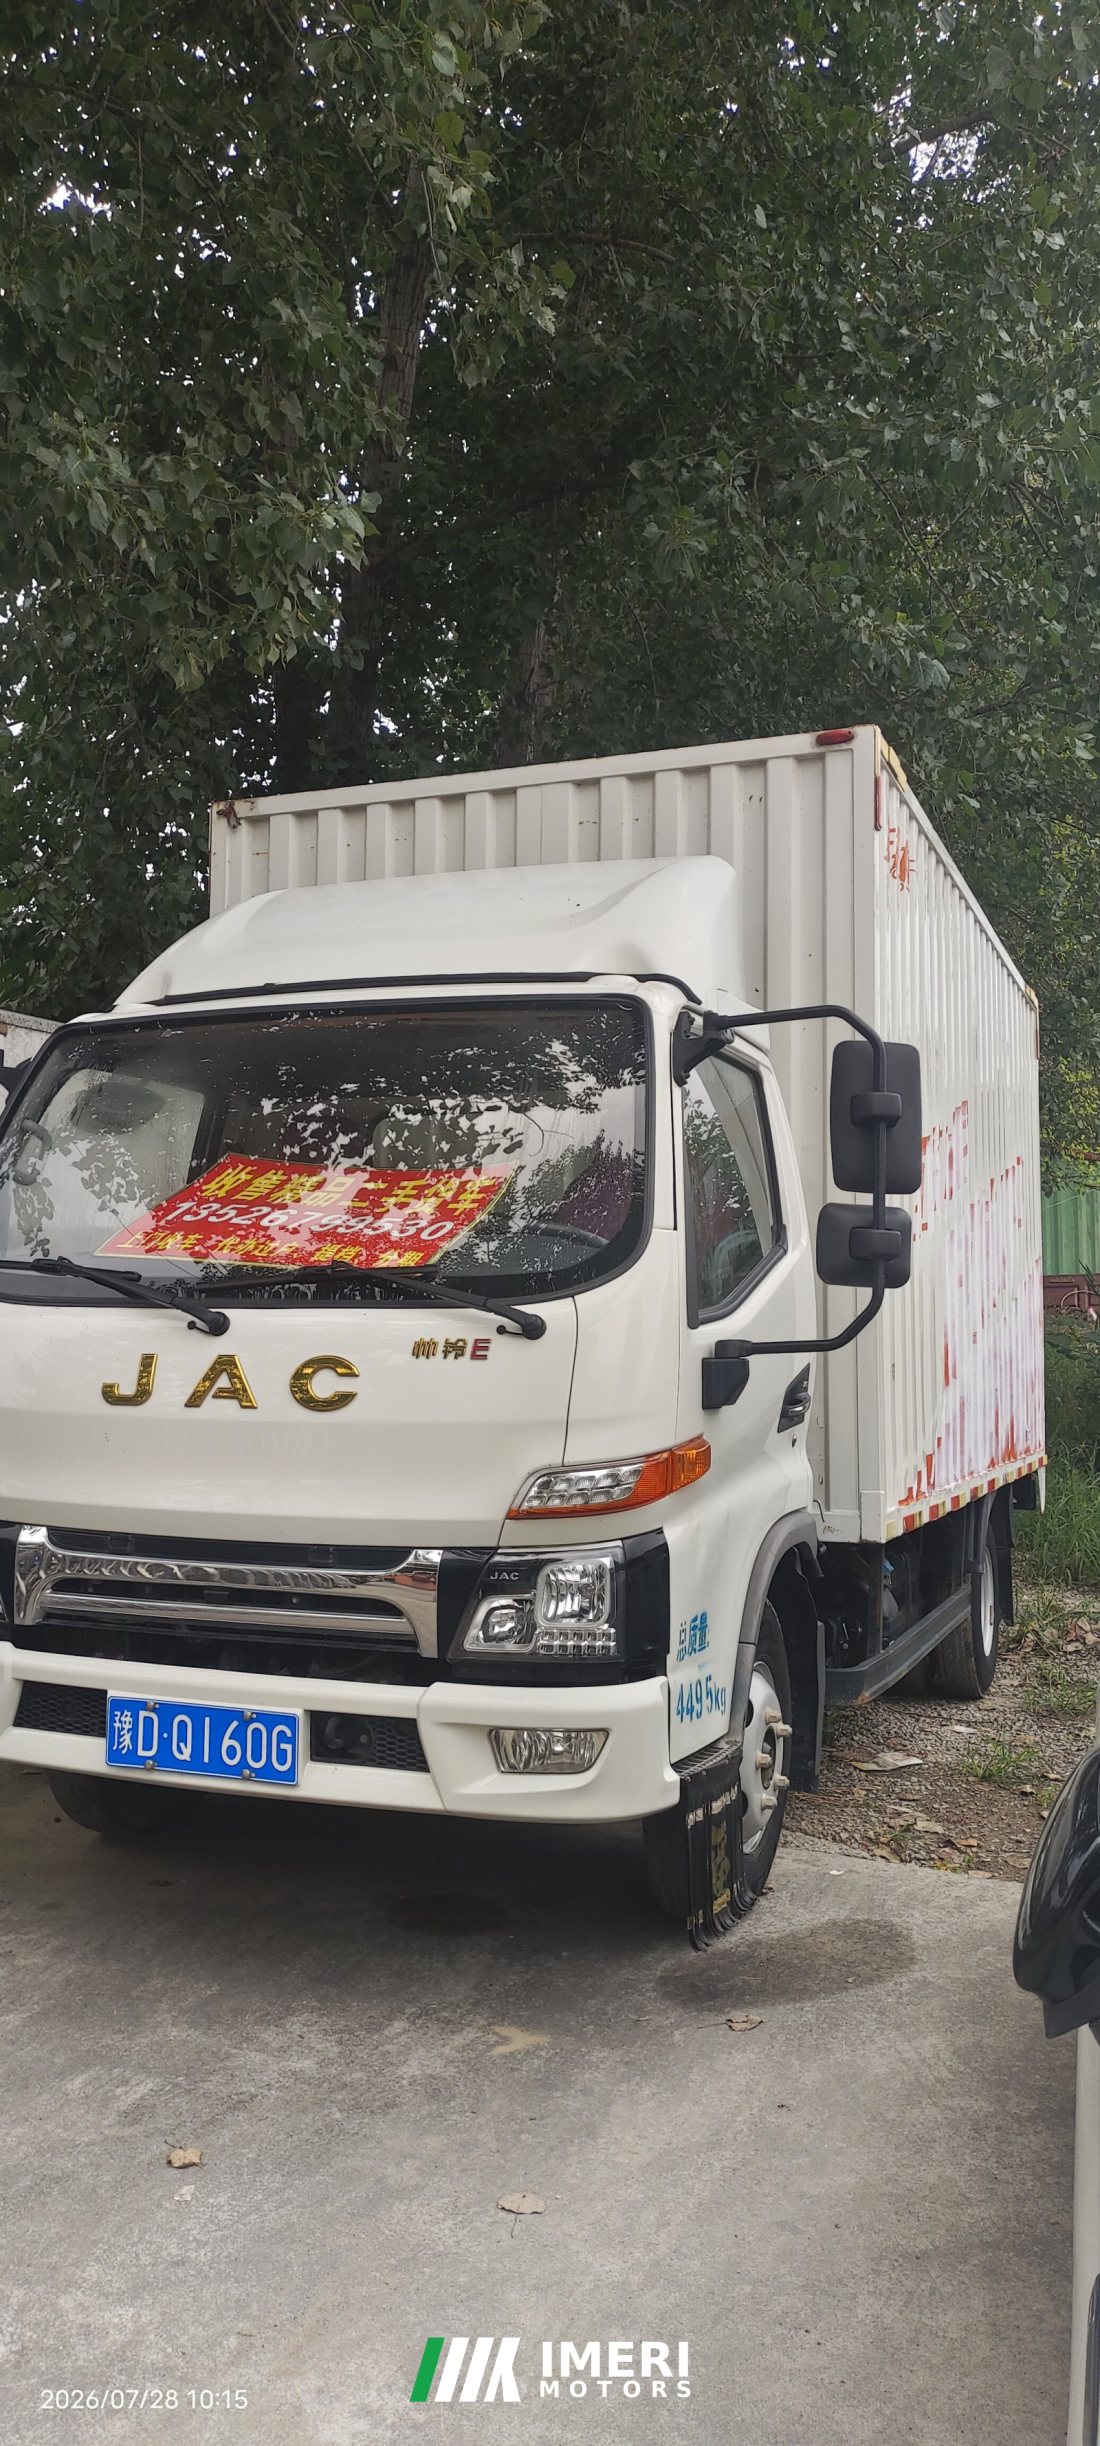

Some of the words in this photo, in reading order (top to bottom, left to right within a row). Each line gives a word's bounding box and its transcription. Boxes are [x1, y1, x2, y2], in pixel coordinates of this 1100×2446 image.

[201, 1163, 496, 1215] 收售精品二手货车
[165, 1202, 454, 1240] 13526799530
[101, 1352, 360, 1412] JAC
[489, 1571, 520, 1581] JAC
